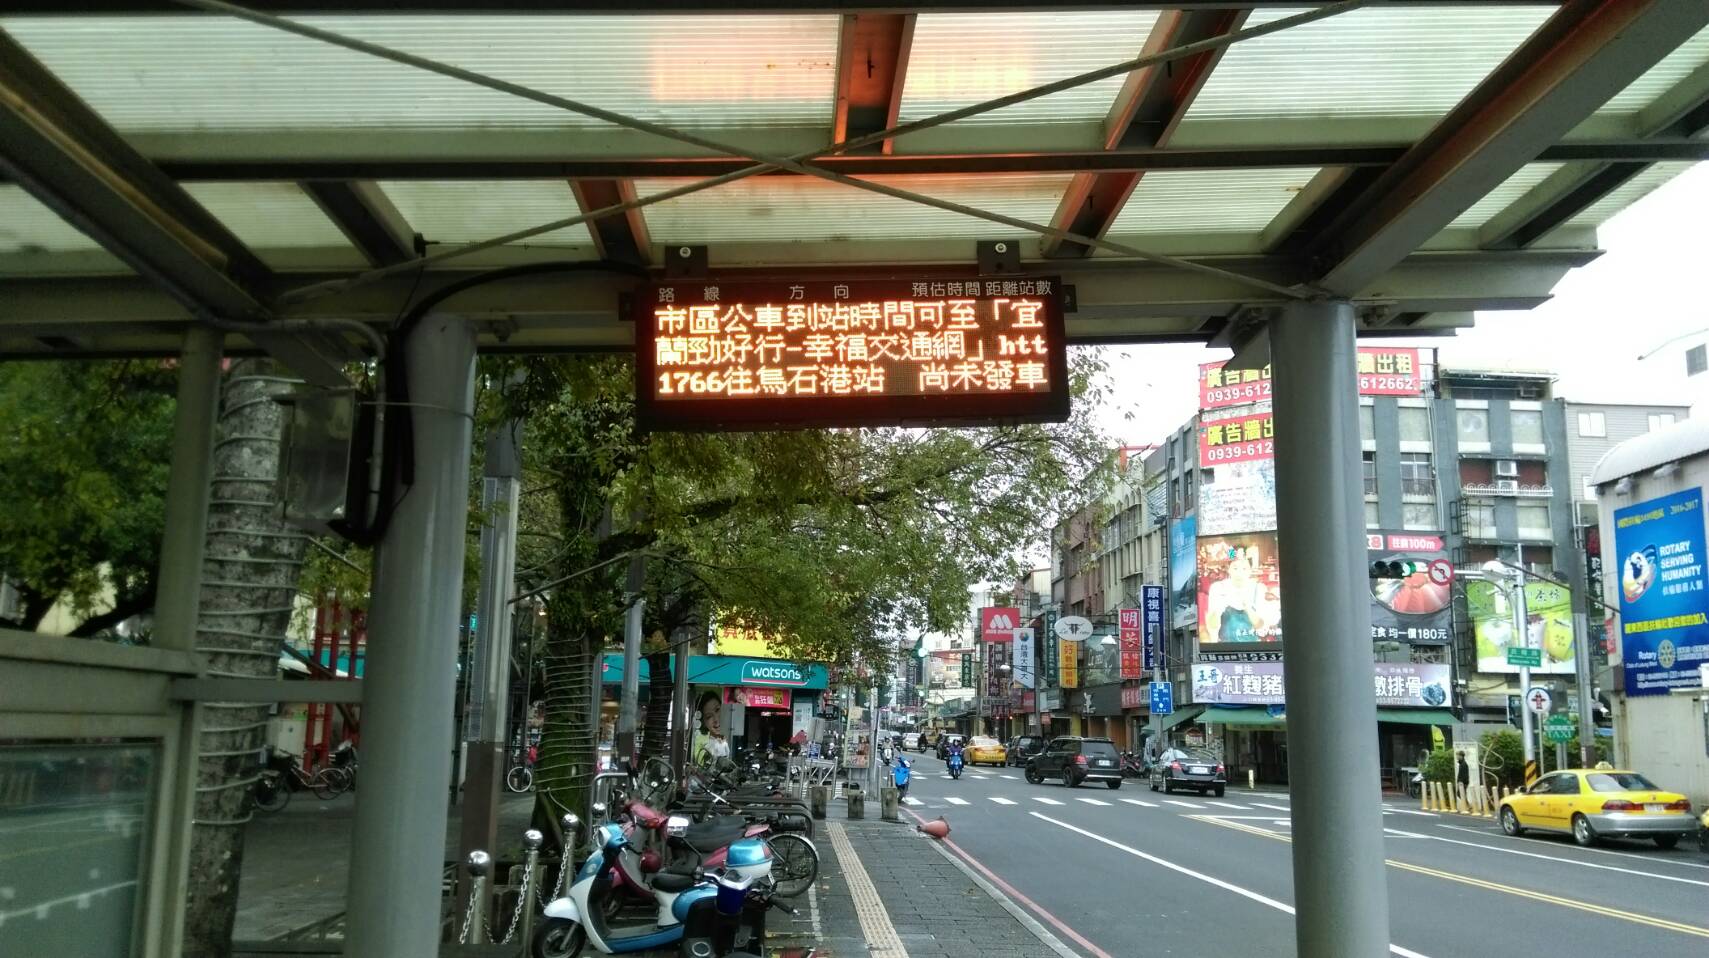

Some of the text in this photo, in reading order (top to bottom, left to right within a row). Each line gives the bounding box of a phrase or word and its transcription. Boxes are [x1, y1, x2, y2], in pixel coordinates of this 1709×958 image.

[911, 280, 1052, 297] 預估時間 距離站數
[999, 334, 1048, 355] htt
[919, 360, 1048, 391] 尚未發車
[1207, 382, 1271, 403] 0939-612
[1208, 442, 1273, 460] 0939-612
[1659, 540, 1690, 557] ROTARY
[1661, 553, 1694, 569] SERVING
[1662, 564, 1702, 582] HUMANITY
[751, 666, 801, 680] watsons
